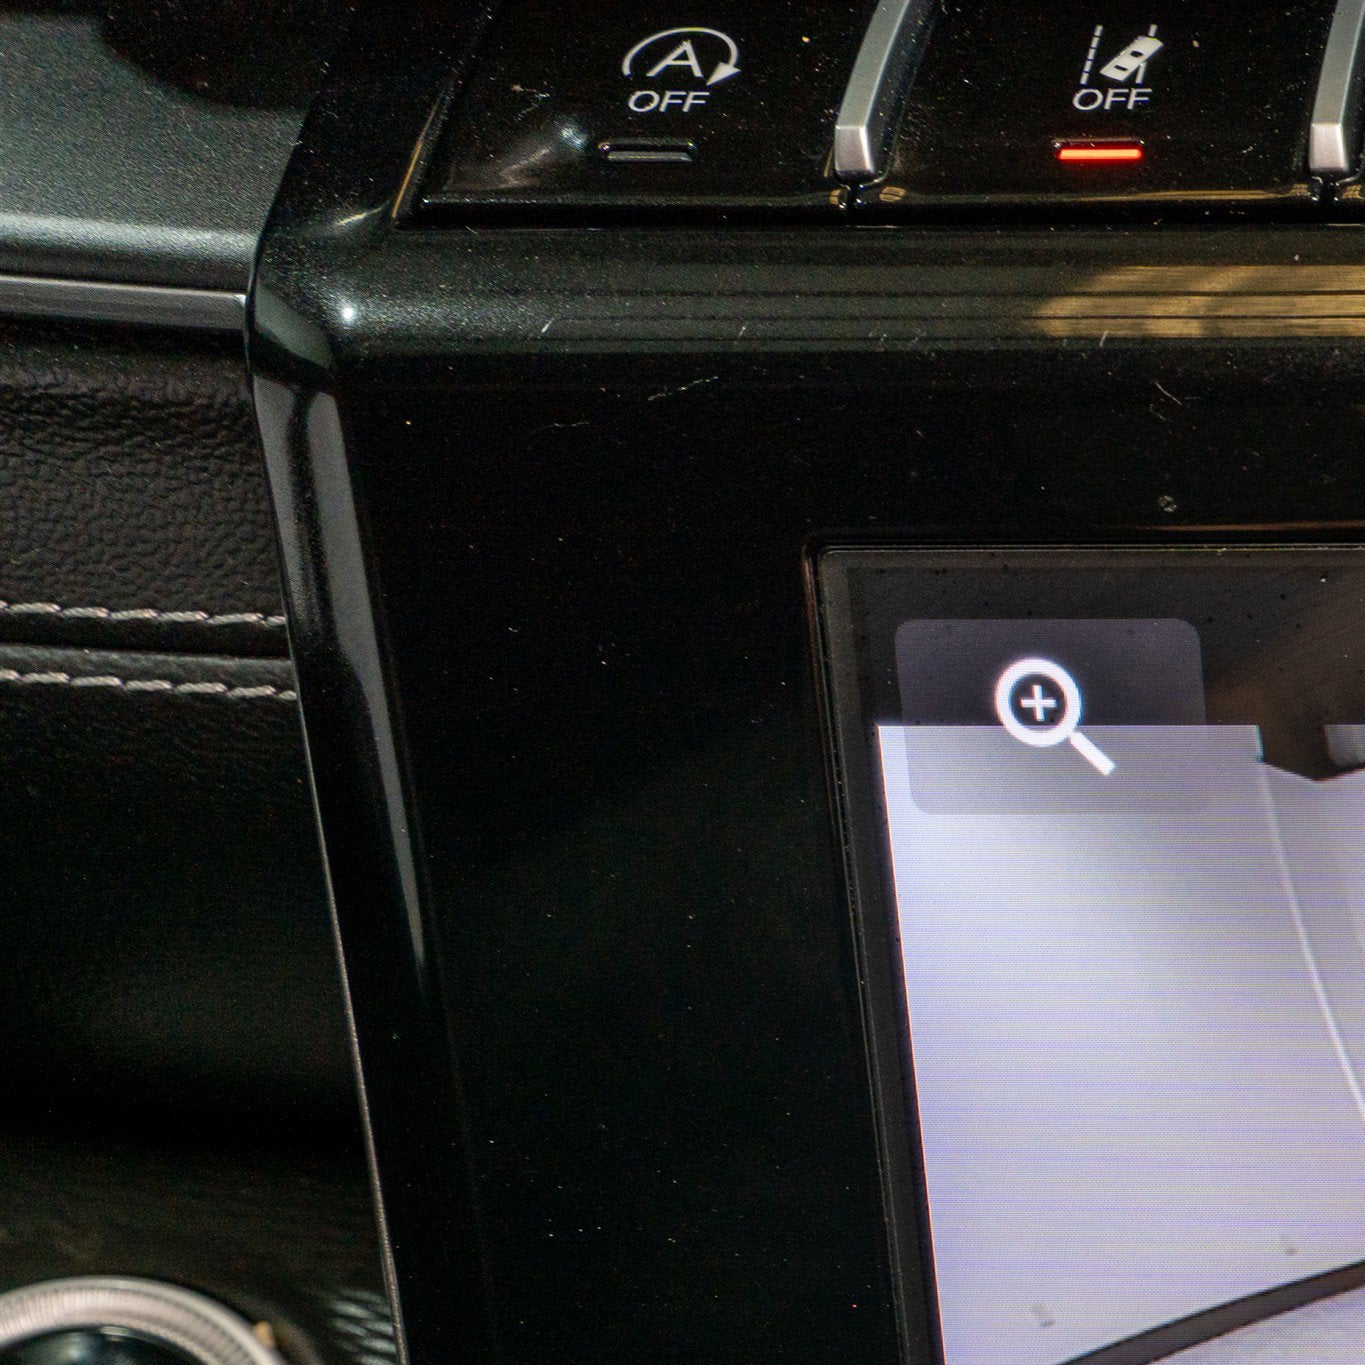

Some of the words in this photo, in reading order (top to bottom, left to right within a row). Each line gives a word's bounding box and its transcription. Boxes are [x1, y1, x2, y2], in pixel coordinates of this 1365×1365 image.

[646, 39, 704, 78] A
[628, 90, 711, 113] OFF
[1072, 88, 1153, 111] OFF
